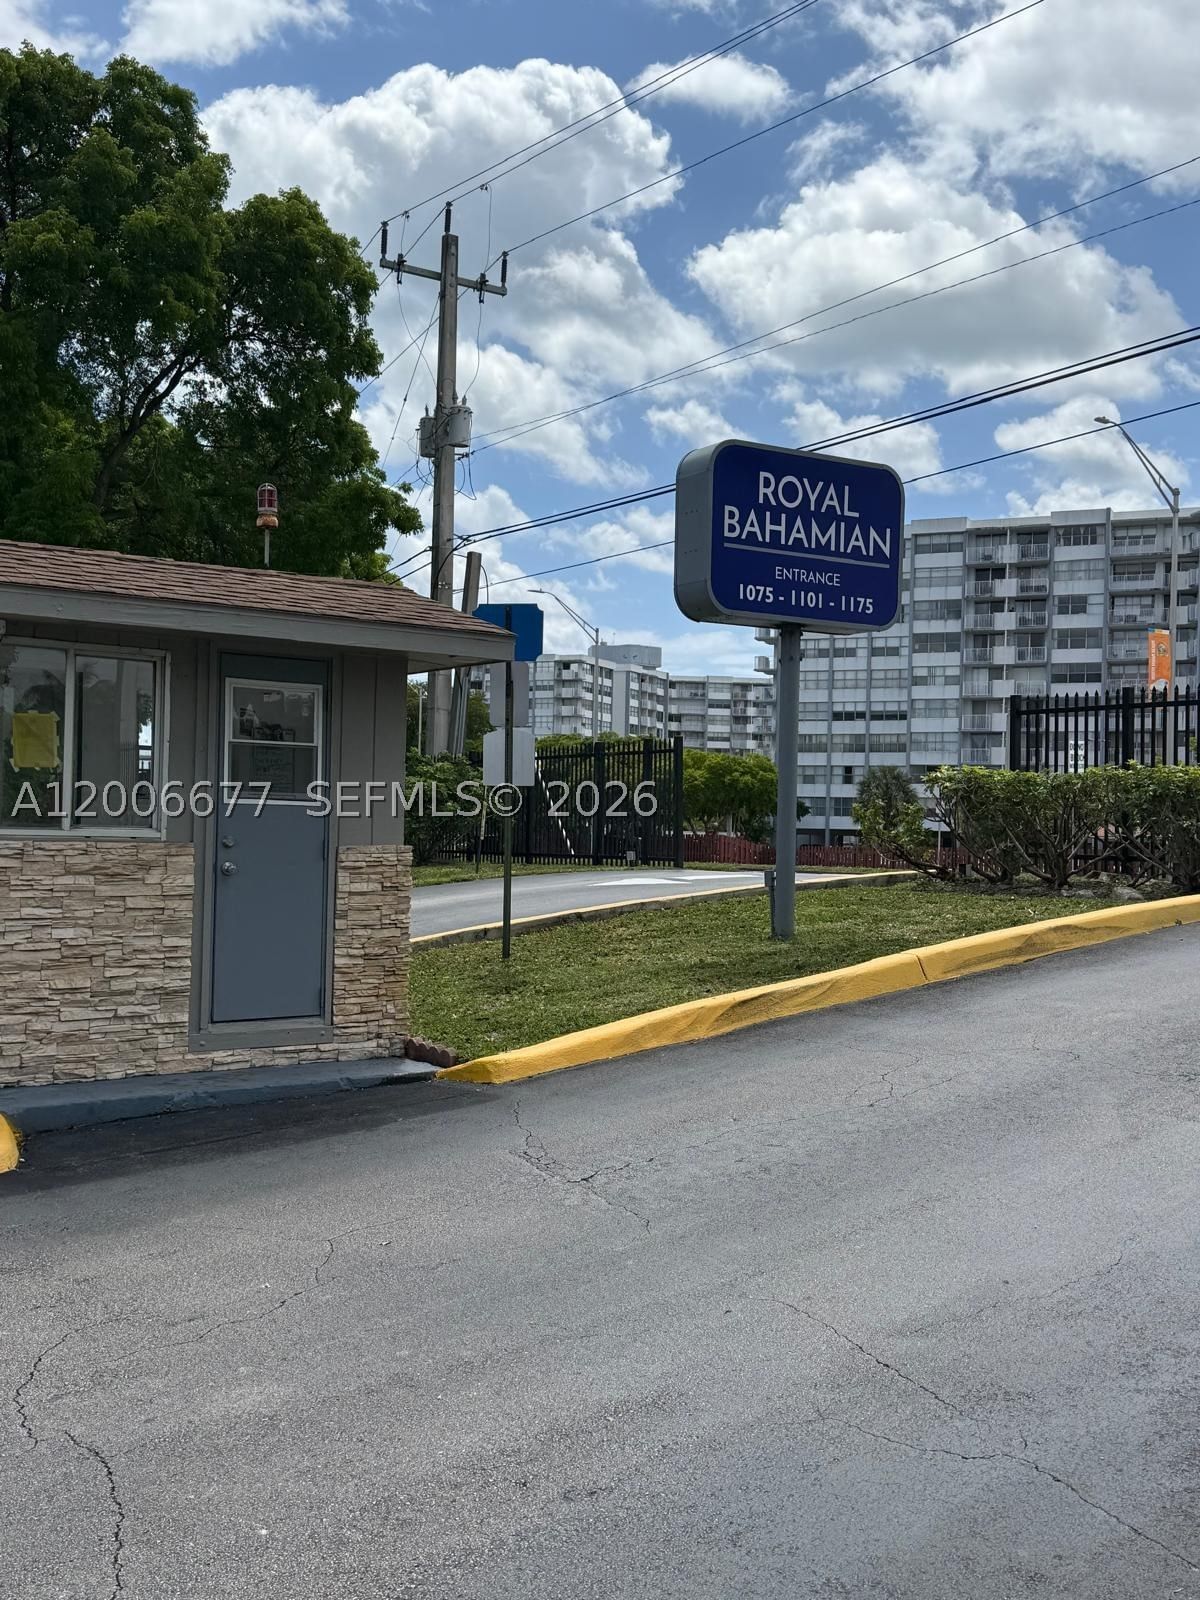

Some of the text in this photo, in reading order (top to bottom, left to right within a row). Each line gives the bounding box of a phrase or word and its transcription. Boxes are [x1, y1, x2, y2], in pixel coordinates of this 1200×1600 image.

[758, 471, 860, 518] ROYAL
[723, 504, 891, 559] BAHAMIAN
[775, 566, 841, 587] ENTRANCE
[739, 583, 774, 603] 1075
[791, 590, 823, 609] 1101
[841, 595, 874, 614] 1175
